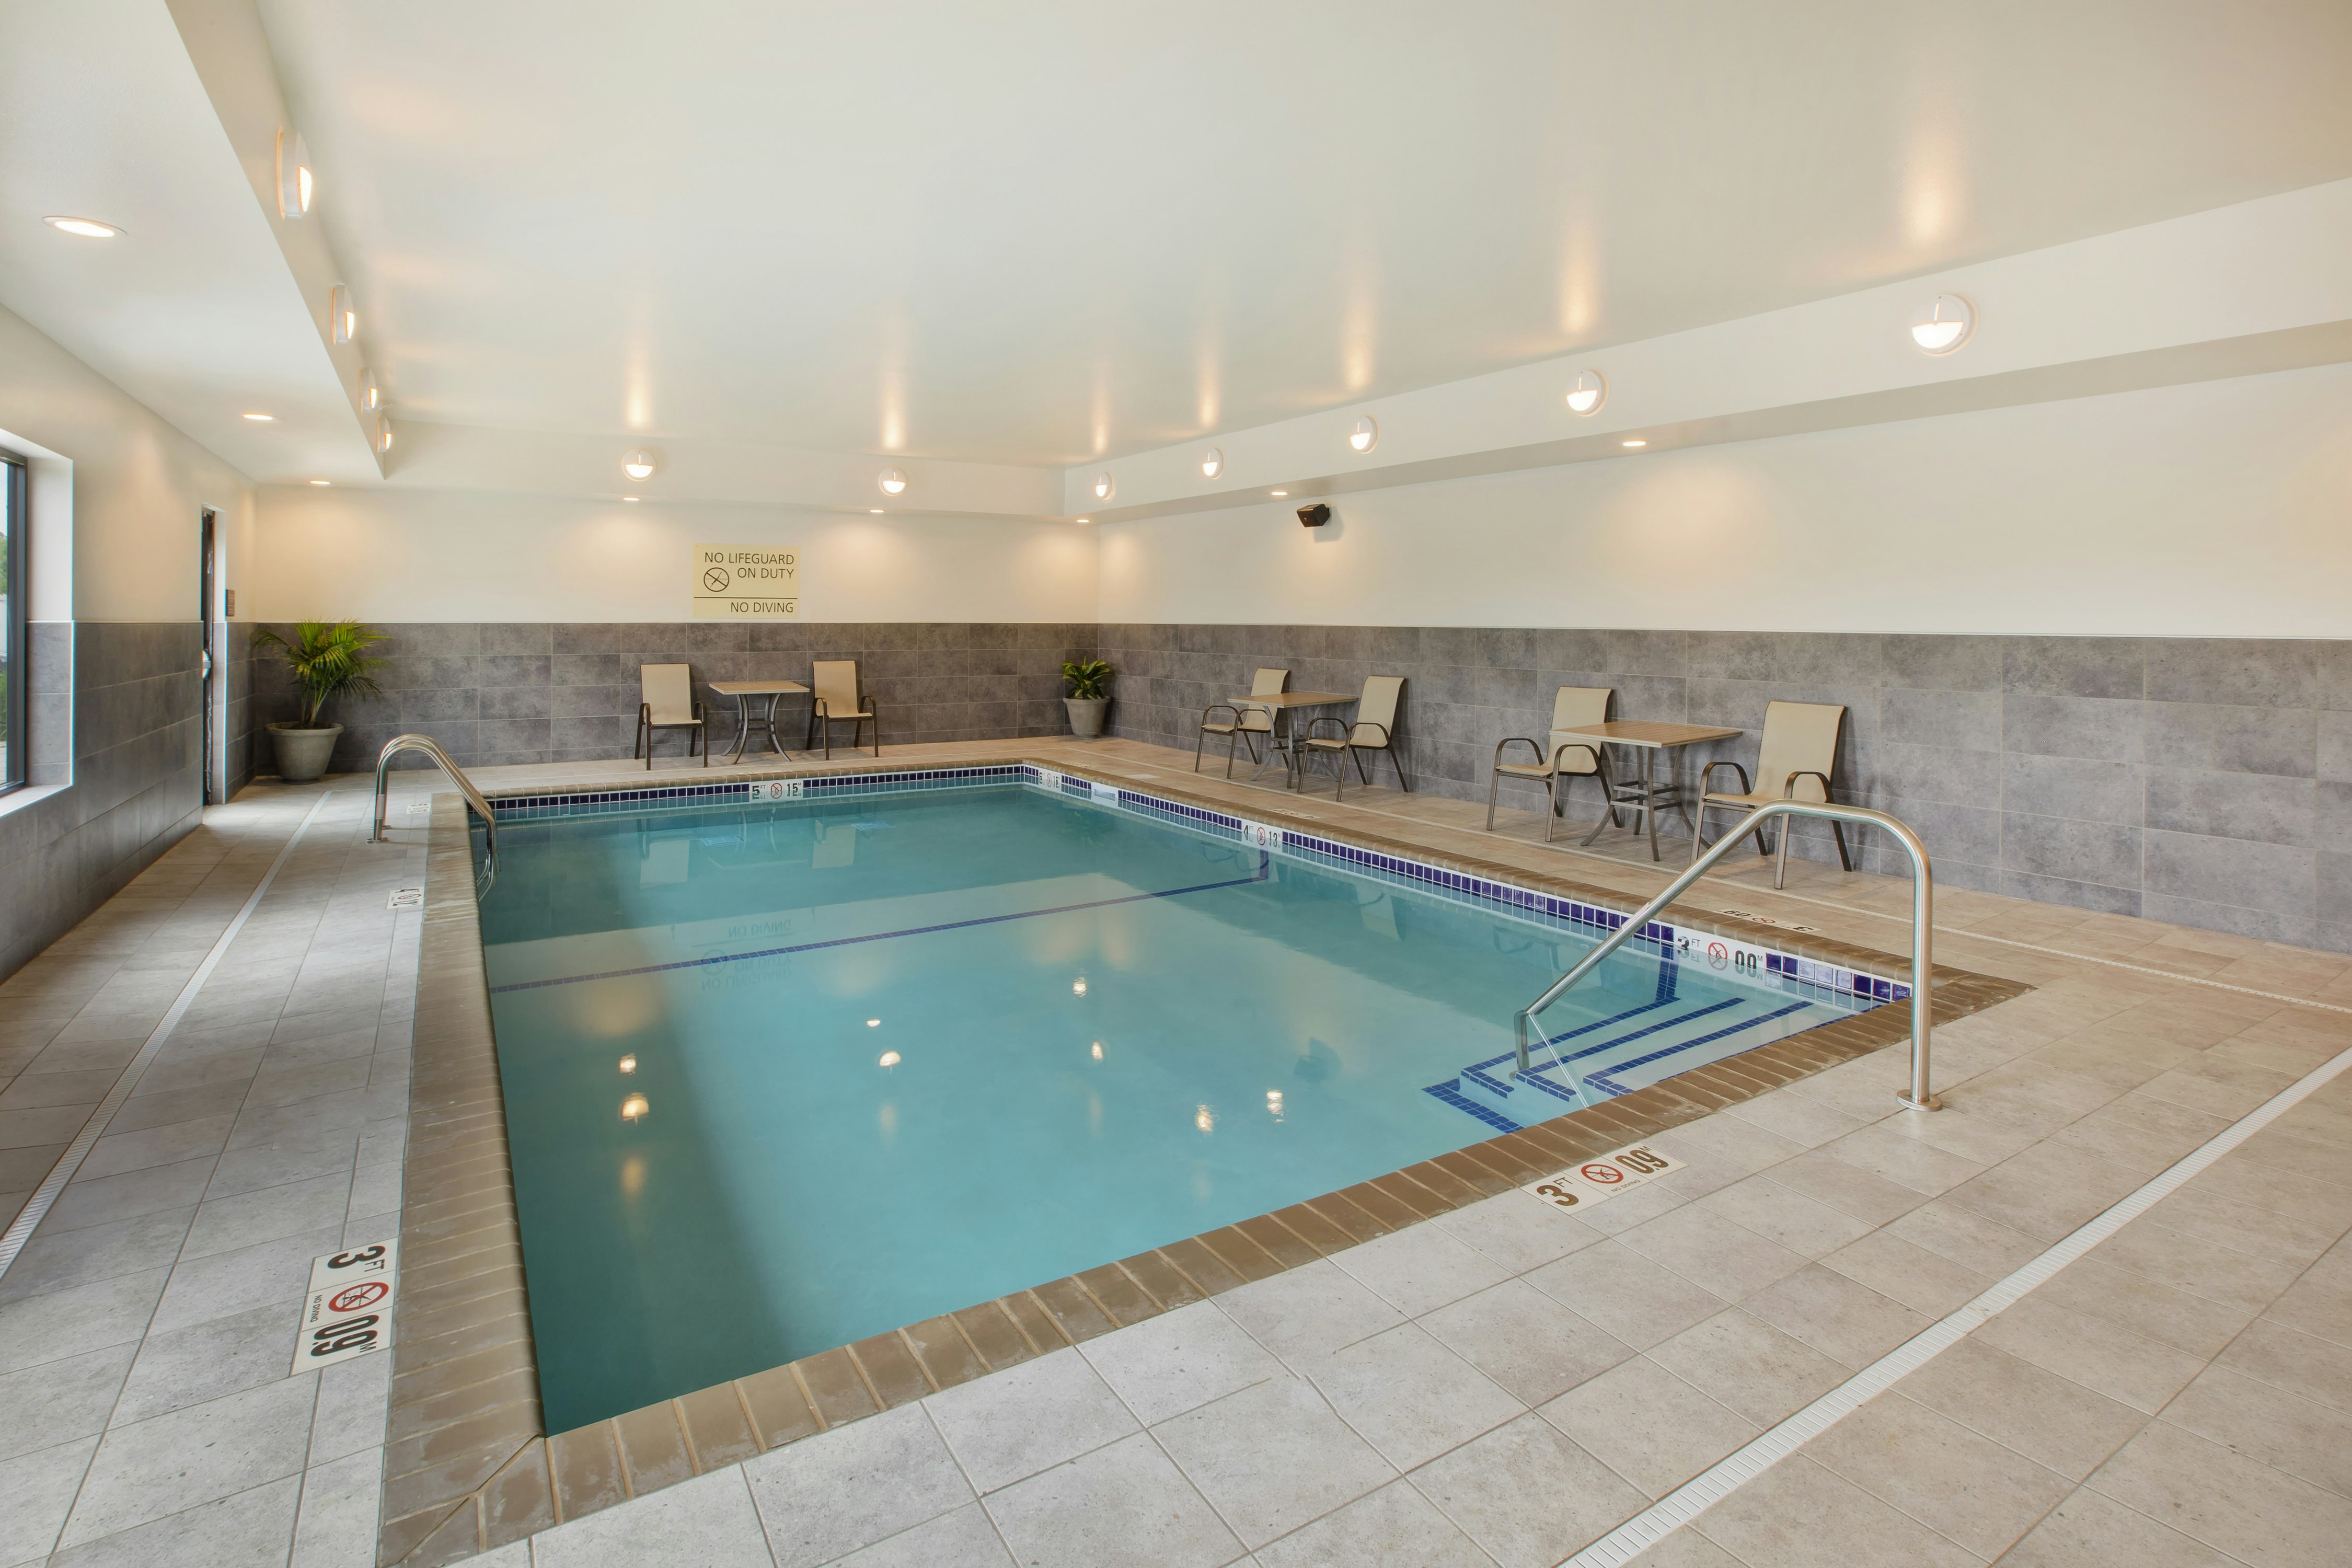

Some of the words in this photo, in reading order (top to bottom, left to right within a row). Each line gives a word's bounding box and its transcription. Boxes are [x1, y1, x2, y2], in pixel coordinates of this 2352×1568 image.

[705, 552, 724, 563] NO
[729, 553, 794, 564] LIFEGUARD
[737, 567, 756, 578] ON
[761, 568, 794, 579] DUTY
[731, 602, 748, 613] NO
[753, 602, 793, 613] DIVING
[1691, 938, 1700, 947] FT
[1553, 1177, 1574, 1187] FT
[1537, 1184, 1579, 1206] 3
[328, 1246, 386, 1269] 3
[364, 1259, 385, 1273] FT
[314, 1294, 322, 1304] NO
